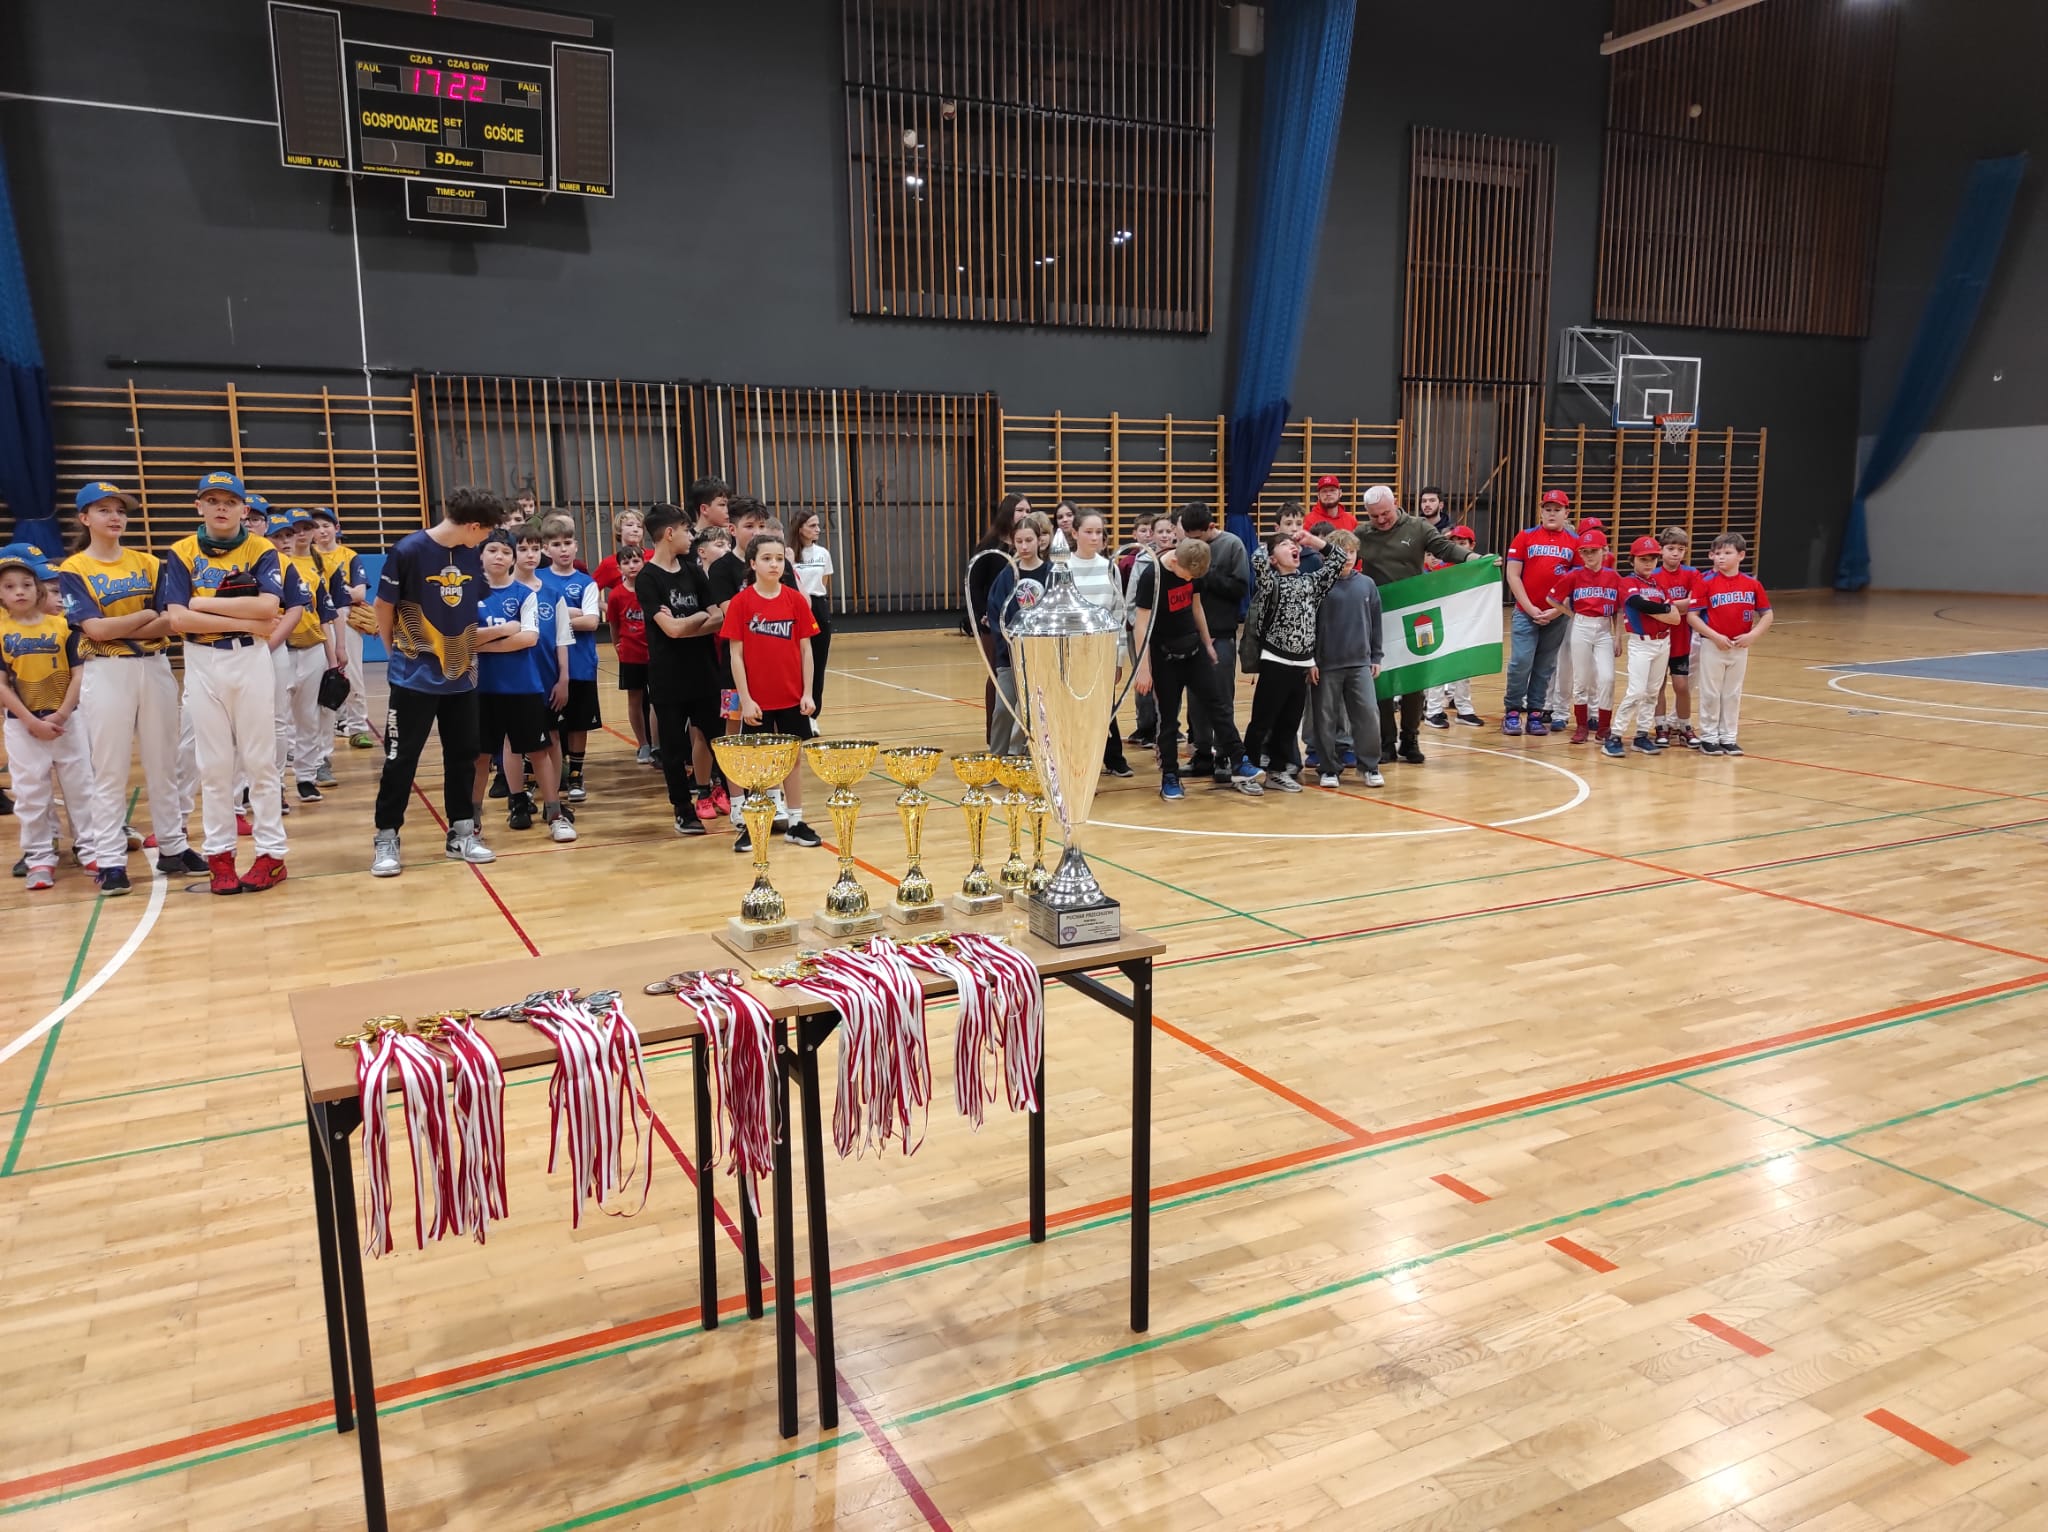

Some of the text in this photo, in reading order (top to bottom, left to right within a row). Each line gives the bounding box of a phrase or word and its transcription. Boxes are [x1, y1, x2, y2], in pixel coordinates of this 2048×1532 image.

[409, 54, 434, 65] CZAS
[447, 58, 490, 72] CZAS GRY
[357, 62, 382, 73] FAUL
[517, 82, 541, 93] FAUL
[362, 111, 438, 134] GOSPODARZE
[443, 117, 462, 128] SET
[484, 123, 524, 143] GOŚCIE
[287, 154, 342, 168] NUMER FAUL
[435, 151, 455, 165] 3D
[436, 187, 475, 198] TIME-OUT
[559, 182, 607, 194] NUMER FAUL
[88, 569, 154, 598] Rapid
[51, 655, 58, 669] 1
[387, 708, 399, 761] NIKE AIR
